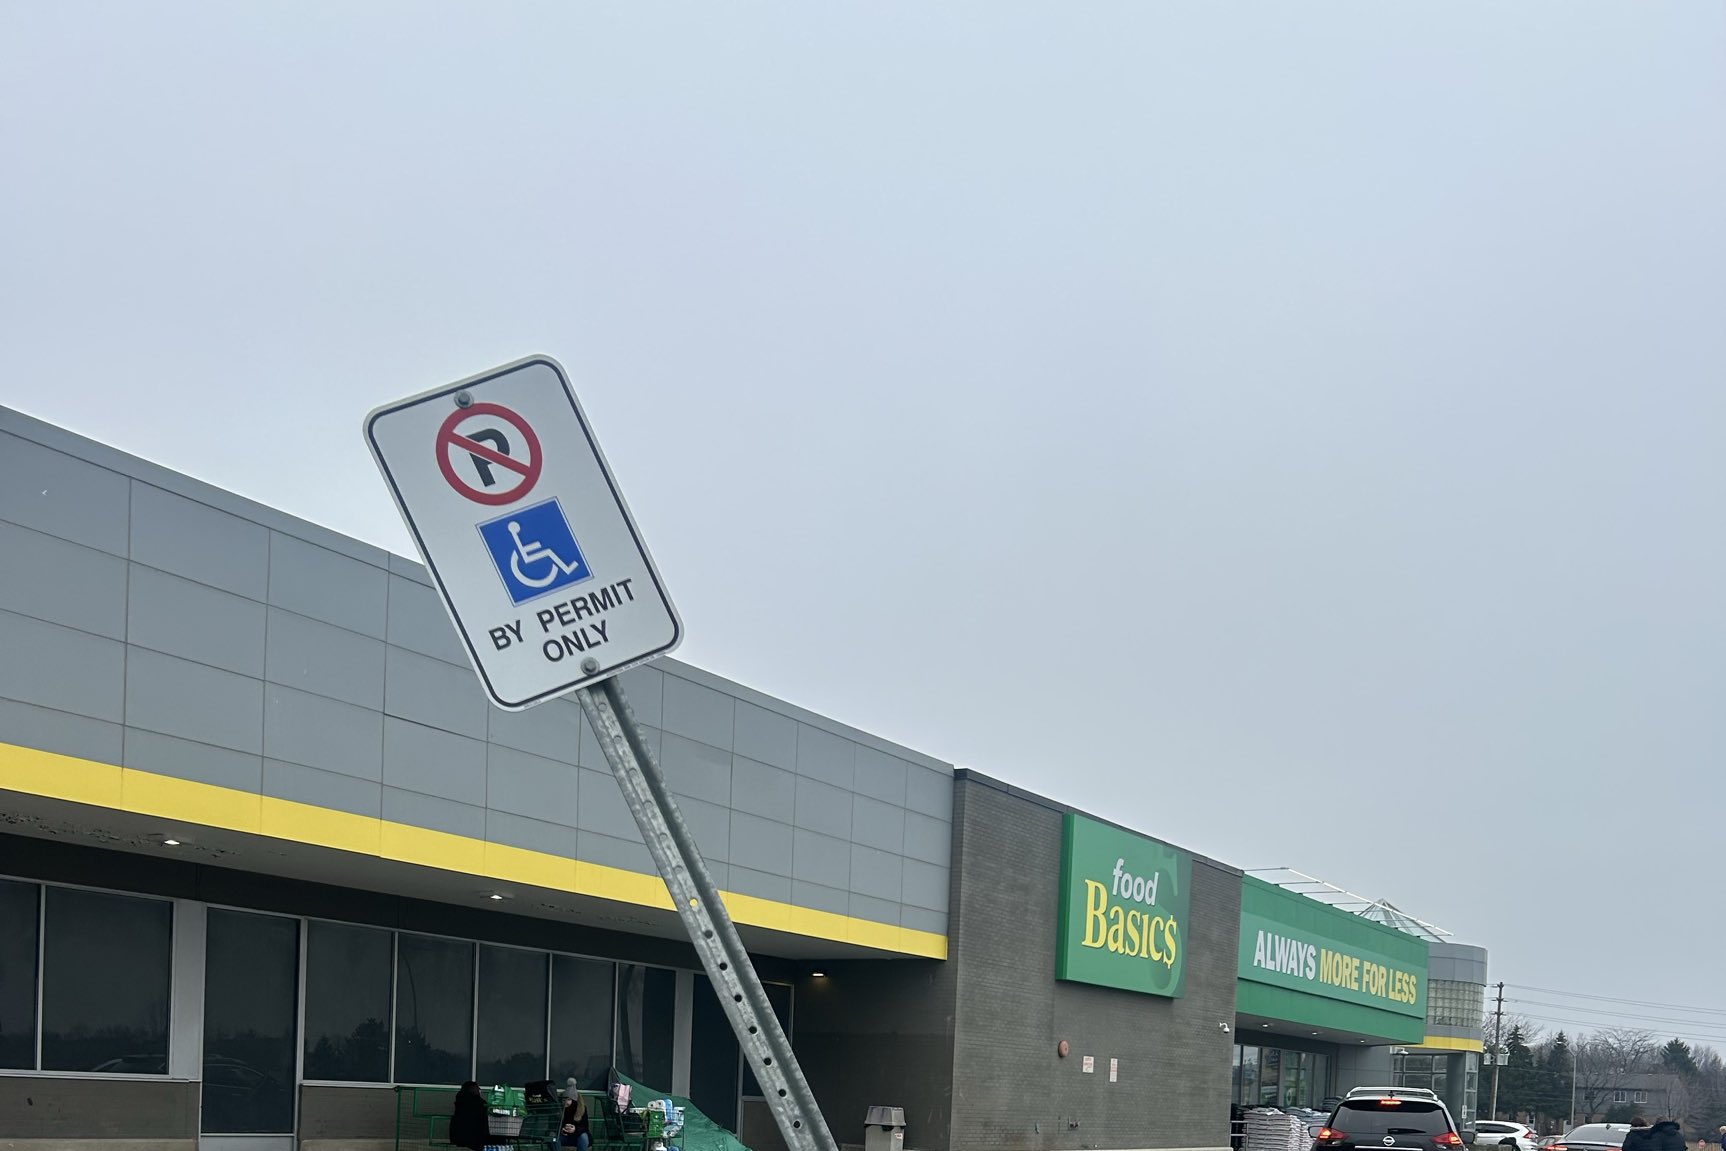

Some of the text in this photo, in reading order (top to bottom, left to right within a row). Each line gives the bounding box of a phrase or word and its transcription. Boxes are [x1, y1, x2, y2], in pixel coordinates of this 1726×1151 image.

[465, 428, 511, 487] P
[488, 578, 635, 651] BY PERMIT
[542, 619, 609, 662] ONLY
[1112, 858, 1159, 906] food
[1253, 930, 1417, 1005] ALWAYS MORE FOR LESS
